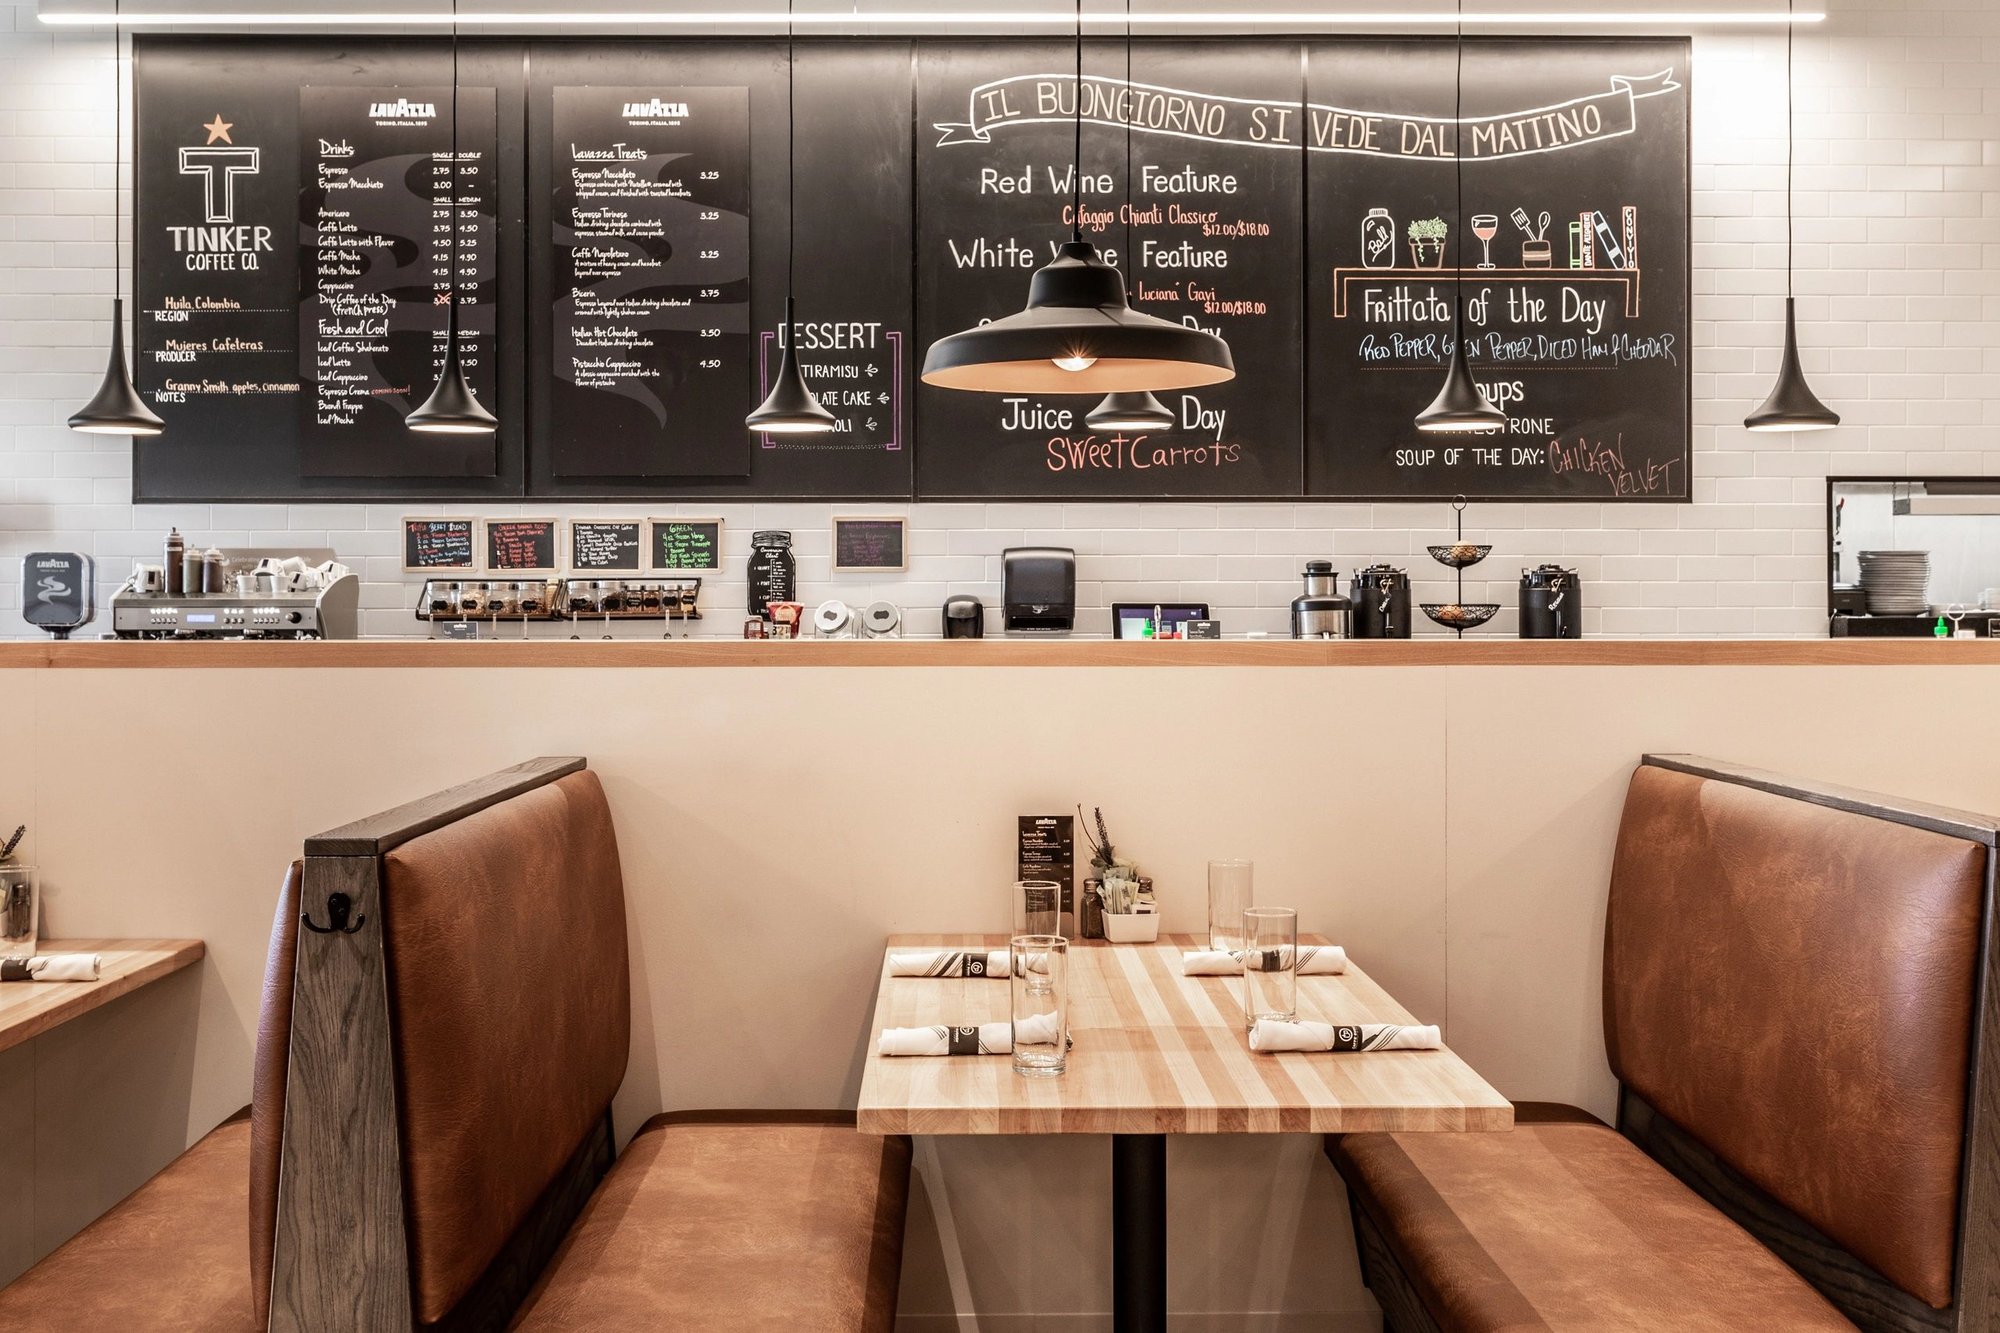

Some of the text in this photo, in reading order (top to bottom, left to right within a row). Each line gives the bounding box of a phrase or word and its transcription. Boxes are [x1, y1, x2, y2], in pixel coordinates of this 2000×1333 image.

[369, 98, 436, 117] LAVAZZA
[622, 98, 689, 117] LAVAZZA
[981, 82, 1602, 157] IL BUONGIORNO SI VEDE DAL MATTINO
[318, 139, 355, 156] Drinks
[571, 143, 648, 160] Lavazza Treats
[318, 163, 479, 178] Espresso 2.75 3.50
[572, 167, 601, 182] Espresso
[700, 171, 719, 180] 3.25
[179, 147, 259, 223] T
[318, 178, 452, 193] Espresso Macchiato 3.00
[980, 164, 1238, 194] Red Wine Feature
[318, 207, 479, 218] Americano 2.75 3.50
[572, 207, 719, 222] Espresso Torinese 3.25
[1120, 204, 1163, 227] Chianti
[1169, 205, 1218, 225] Classico
[338, 221, 358, 232] Latte
[166, 226, 273, 252] TINKER
[338, 235, 358, 247] Latte
[358, 236, 374, 247] with
[374, 235, 395, 248] Flavor
[432, 239, 451, 247] 4.50
[459, 239, 477, 247] 5.25
[338, 250, 361, 261] Mocha
[700, 250, 719, 259] 3.25
[949, 238, 1034, 269] White
[1142, 240, 1228, 269] Feature
[186, 252, 259, 271] COFFEE CO.
[317, 267, 338, 276] White
[338, 267, 361, 276] Mocha
[432, 268, 449, 276] 4.15
[318, 279, 478, 294] Cappuccino 3.75 4.50
[571, 287, 720, 298] Bicerin 3.75
[1188, 281, 1216, 302] Gavi
[195, 296, 241, 310] Colombia
[319, 293, 478, 309] Drip Coffee of the Day 3.75
[155, 310, 189, 322] REGION
[1364, 286, 1606, 335] Frittata of the Day
[318, 318, 389, 337] Fresh and Cool
[571, 326, 721, 339] Italian Hot Chocolate 3.50
[778, 322, 882, 349] DESSERT
[166, 337, 263, 352] Mujeres Cafeteras
[317, 341, 332, 352] Iced
[332, 341, 355, 353] Coffee
[156, 351, 196, 363] PRODUCER
[317, 355, 332, 367] Iced
[332, 355, 351, 367] Latte
[433, 359, 445, 367] 3.7
[606, 357, 642, 372] Cappuccino
[700, 360, 721, 368] 4.50
[317, 370, 368, 385] Iced Cappuccino
[800, 364, 859, 379] TIRAMISU
[166, 379, 201, 394] Granny
[202, 379, 229, 393] Smith
[262, 382, 300, 392] cinnamon
[318, 384, 370, 400] Espresso Crema
[156, 391, 186, 403] NOTES
[843, 390, 872, 406] CAKE
[1476, 381, 1524, 411] oups
[342, 399, 364, 415] Frappe
[317, 413, 354, 425] Iced Mocha
[1001, 395, 1226, 441] Juice Day
[1396, 448, 1545, 466] SOUP OF THE DAY:
[1549, 432, 1625, 475] CHICKEN
[1608, 458, 1680, 497] VELVET
